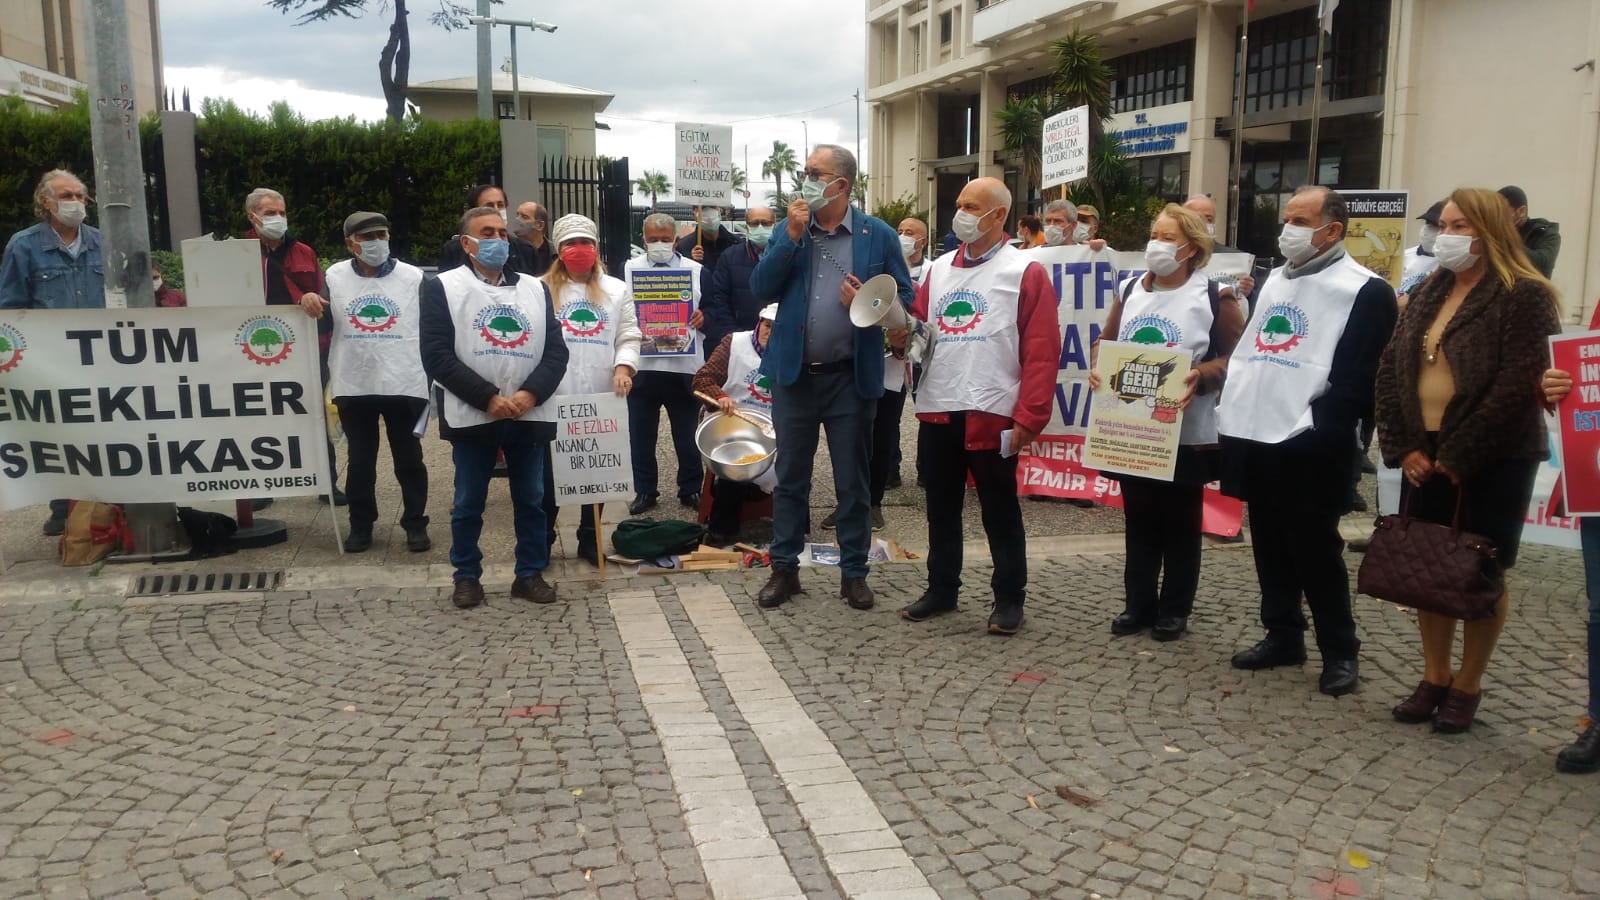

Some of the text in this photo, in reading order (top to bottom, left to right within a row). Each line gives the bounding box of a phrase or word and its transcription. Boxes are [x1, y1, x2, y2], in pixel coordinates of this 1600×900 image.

[1352, 198, 1378, 213] TÜRKİYE
[1378, 198, 1404, 215] GERÇEĞİ
[65, 321, 200, 366] TÜM
[1124, 362, 1160, 375] ZAMLAR
[1123, 371, 1159, 389] GERİ
[1121, 385, 1157, 397] ÇEKİLSİN
[569, 402, 598, 418] EZEN
[567, 418, 618, 437] NE EZİLEN
[0, 432, 303, 479] SENDİKASI
[570, 452, 621, 470] BİR DÜZEN
[187, 473, 318, 492] BORNOVA ŞUBESİ
[558, 481, 629, 496] TÜM EMEKLİ-SEN
[1023, 462, 1121, 498] İZMİR ŞU
